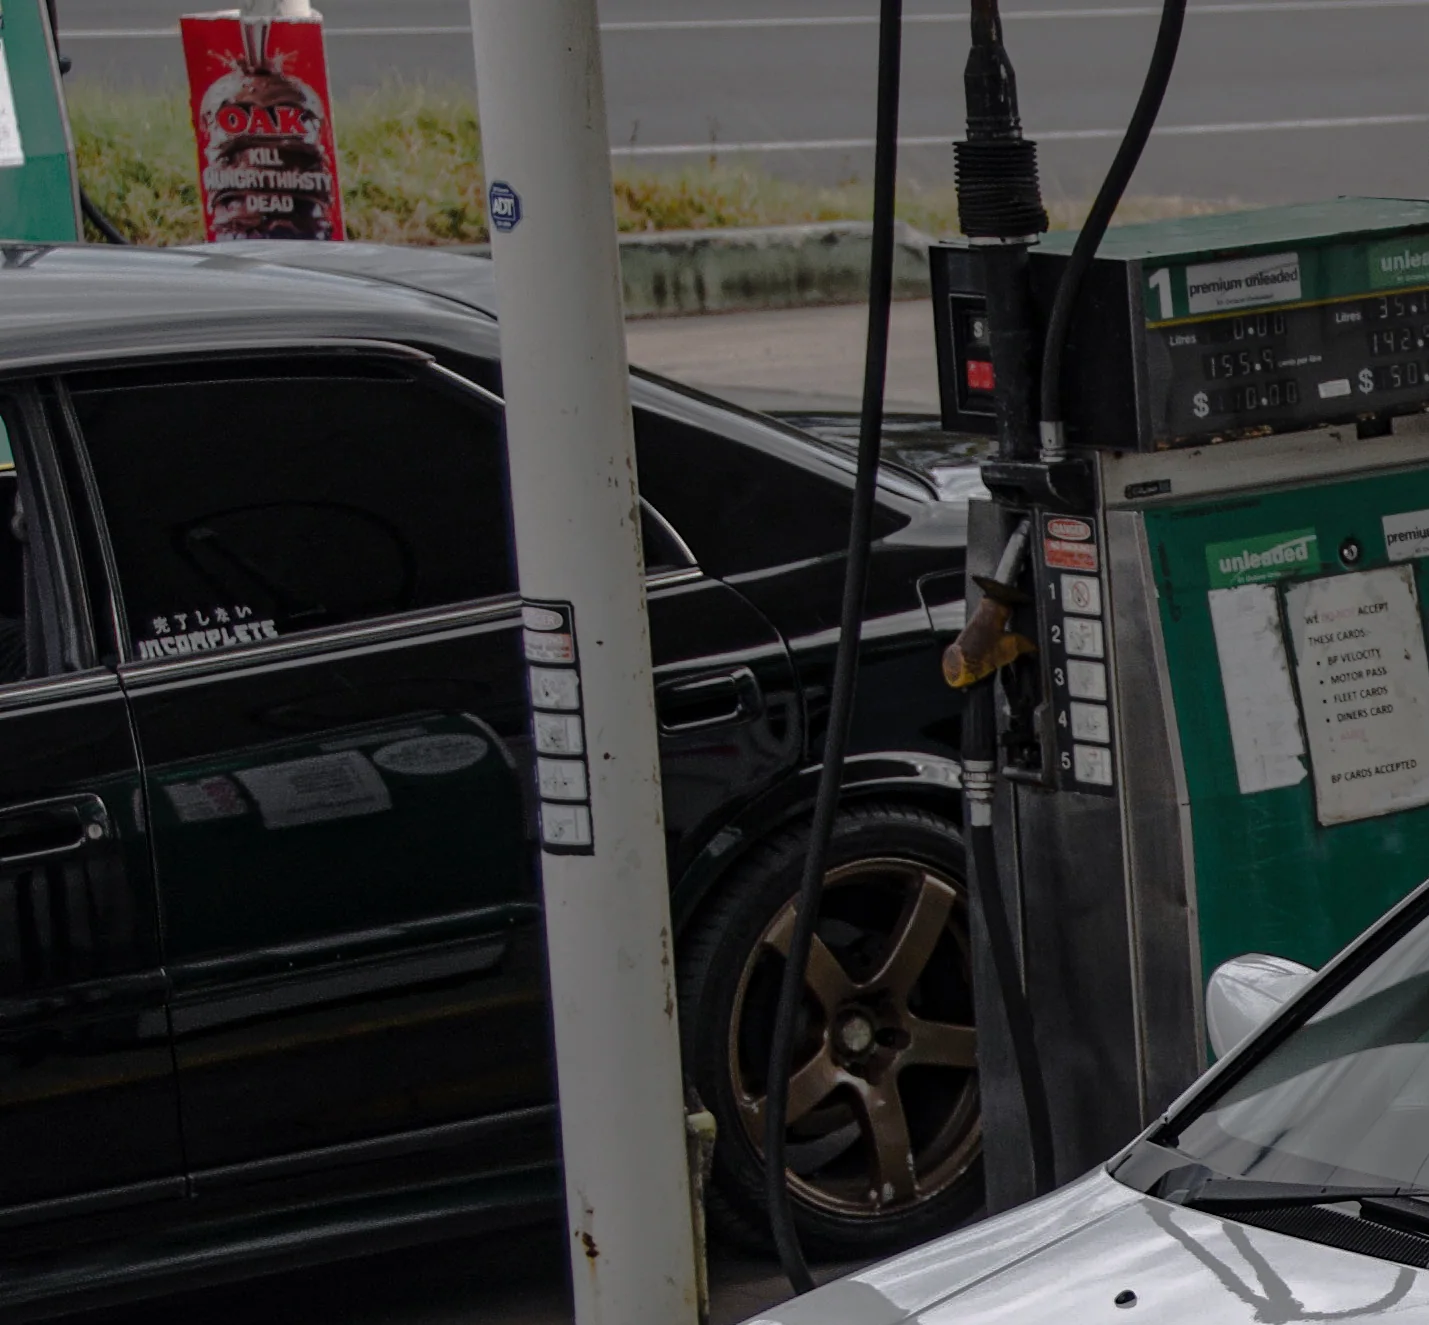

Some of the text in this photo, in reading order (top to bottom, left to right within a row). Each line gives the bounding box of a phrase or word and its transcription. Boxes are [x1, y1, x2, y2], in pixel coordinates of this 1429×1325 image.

[216, 105, 307, 135] OAK
[249, 148, 283, 165] KILL
[246, 196, 294, 212] DEAD
[493, 197, 514, 216] ADT
[1189, 269, 1298, 297] premium unleaded
[1148, 267, 1174, 319] 1
[1335, 312, 1361, 324] Litres
[1169, 334, 1197, 347] Litres
[1358, 368, 1374, 394] $
[1193, 391, 1209, 418] $
[1220, 541, 1308, 573] unleaded
[1048, 583, 1056, 600] 1
[1358, 602, 1388, 615] ACCEPT
[138, 619, 279, 660] INCOMPLETE
[1051, 624, 1061, 643] 2
[1308, 633, 1335, 646] THESE
[1327, 648, 1381, 665] BP VELOCITY
[1054, 668, 1064, 685] 3
[1331, 666, 1387, 684] MOTOR PASS
[1334, 685, 1388, 703] FLEET CARDS
[1058, 710, 1067, 727] 4
[1336, 704, 1393, 722] DINERS CARD
[1061, 752, 1071, 770] 5
[1331, 759, 1417, 784] BP CARDS ACCEPTED
